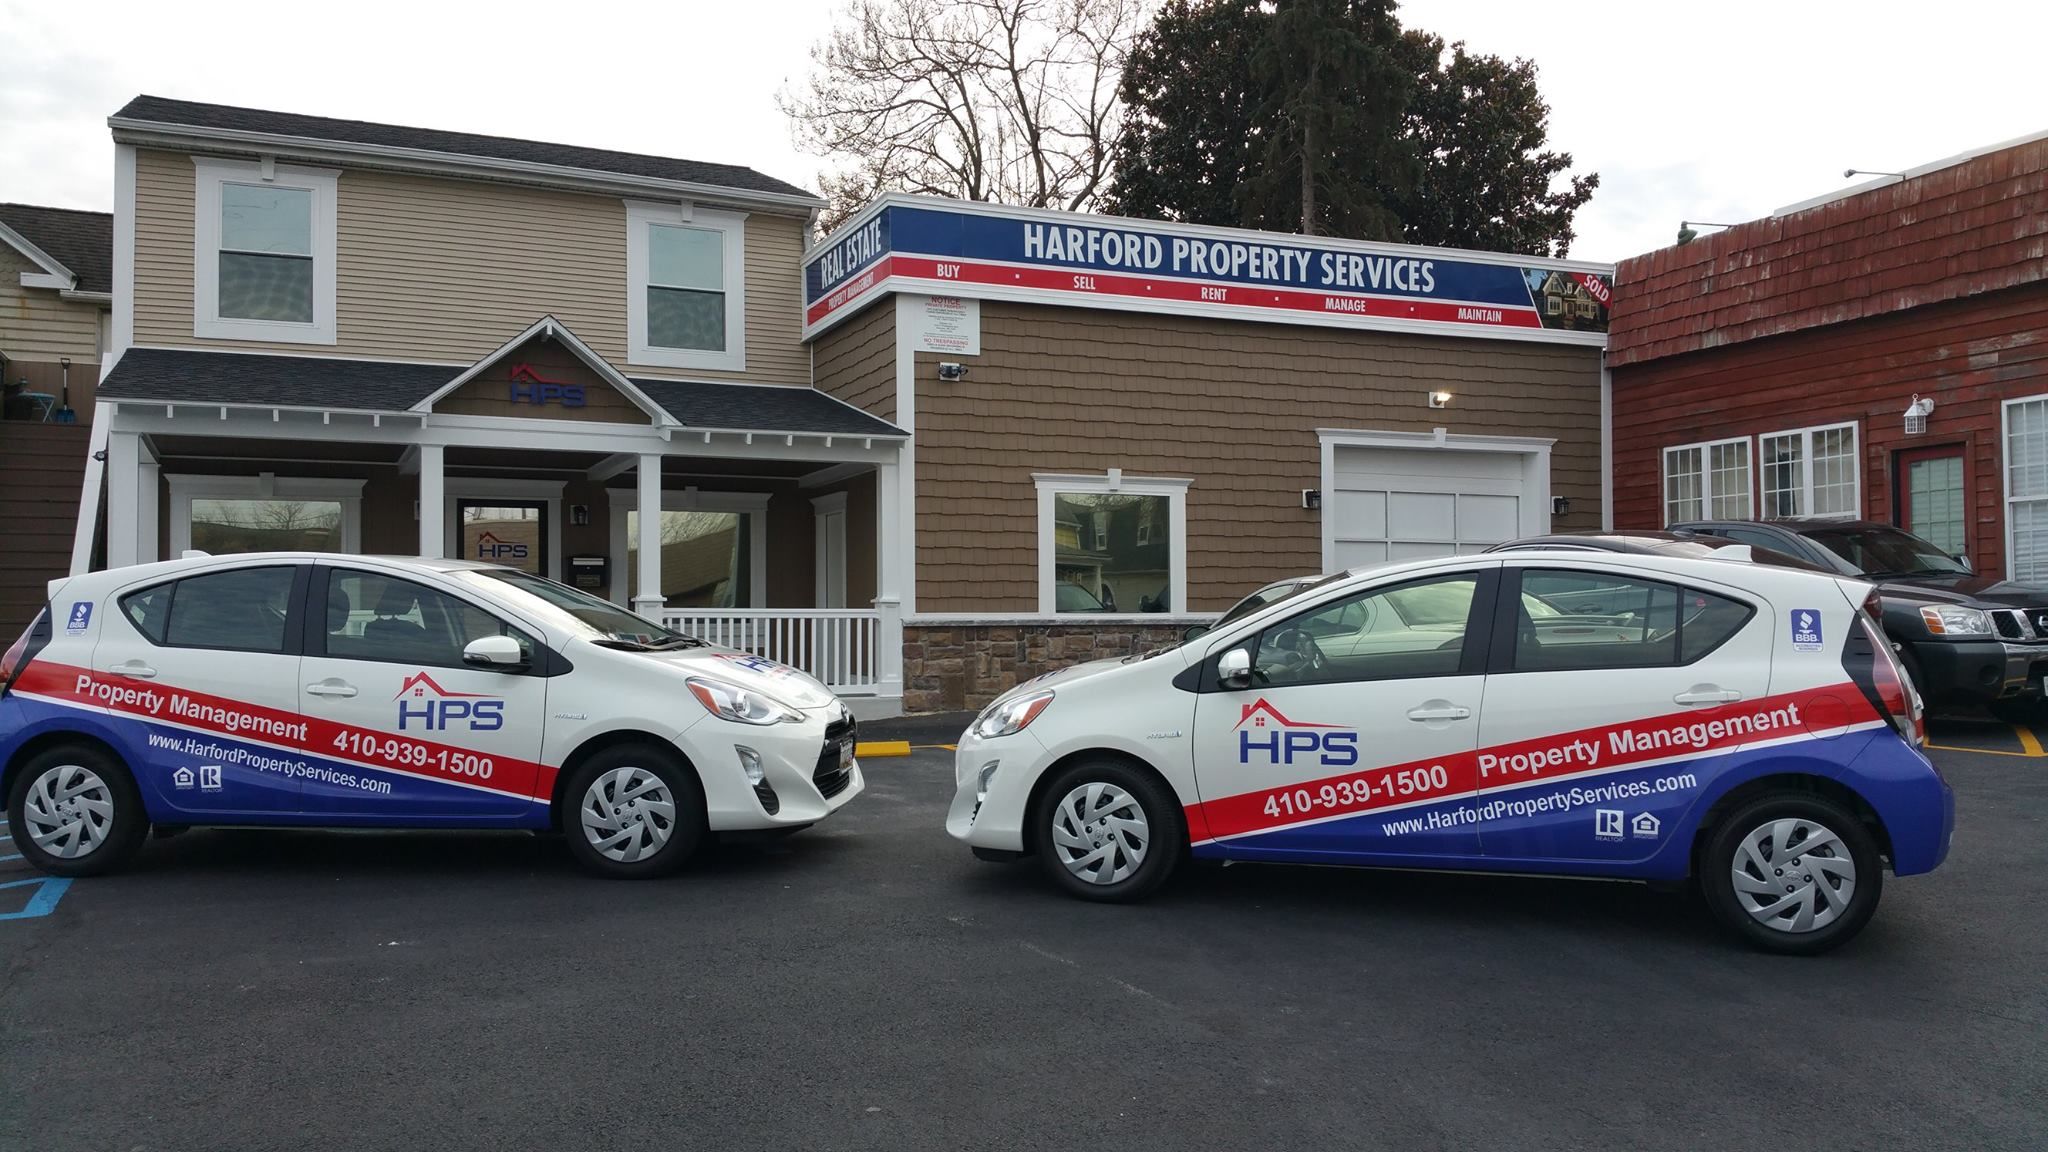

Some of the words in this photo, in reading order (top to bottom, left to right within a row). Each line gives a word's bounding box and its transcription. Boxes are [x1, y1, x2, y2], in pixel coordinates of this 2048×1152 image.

[821, 245, 845, 289] REAL
[846, 216, 882, 272] ESTATE
[1024, 223, 1163, 269] HARFORD
[1173, 238, 1313, 282] PROPERTY
[1321, 253, 1435, 293] SERVICES
[936, 263, 960, 279] BUY
[1073, 275, 1096, 291] SELL
[828, 289, 847, 311] PROPERTY
[847, 271, 874, 299] MANAGEMENT
[931, 296, 961, 306] NOTICE
[1201, 286, 1227, 302] RENT
[1583, 274, 1609, 302] SOLD
[1325, 297, 1366, 313] MANAGE
[1457, 307, 1502, 323] MAINTAIN
[511, 382, 586, 407] HPS
[479, 544, 528, 558] HPS
[1795, 633, 1818, 642] BBB
[75, 674, 165, 715] Property
[169, 695, 308, 742] Management
[333, 730, 494, 780] 410-939-1500
[398, 700, 504, 731] HPS
[1239, 730, 1359, 766] HPS
[1263, 764, 1448, 818] 410-939-1500
[1478, 736, 1601, 778] Property
[1608, 703, 1801, 757] Management
[148, 733, 392, 795] www.HarfordPropertyServices.com
[1382, 771, 1698, 838] www.HarfordPropertyServices.com
